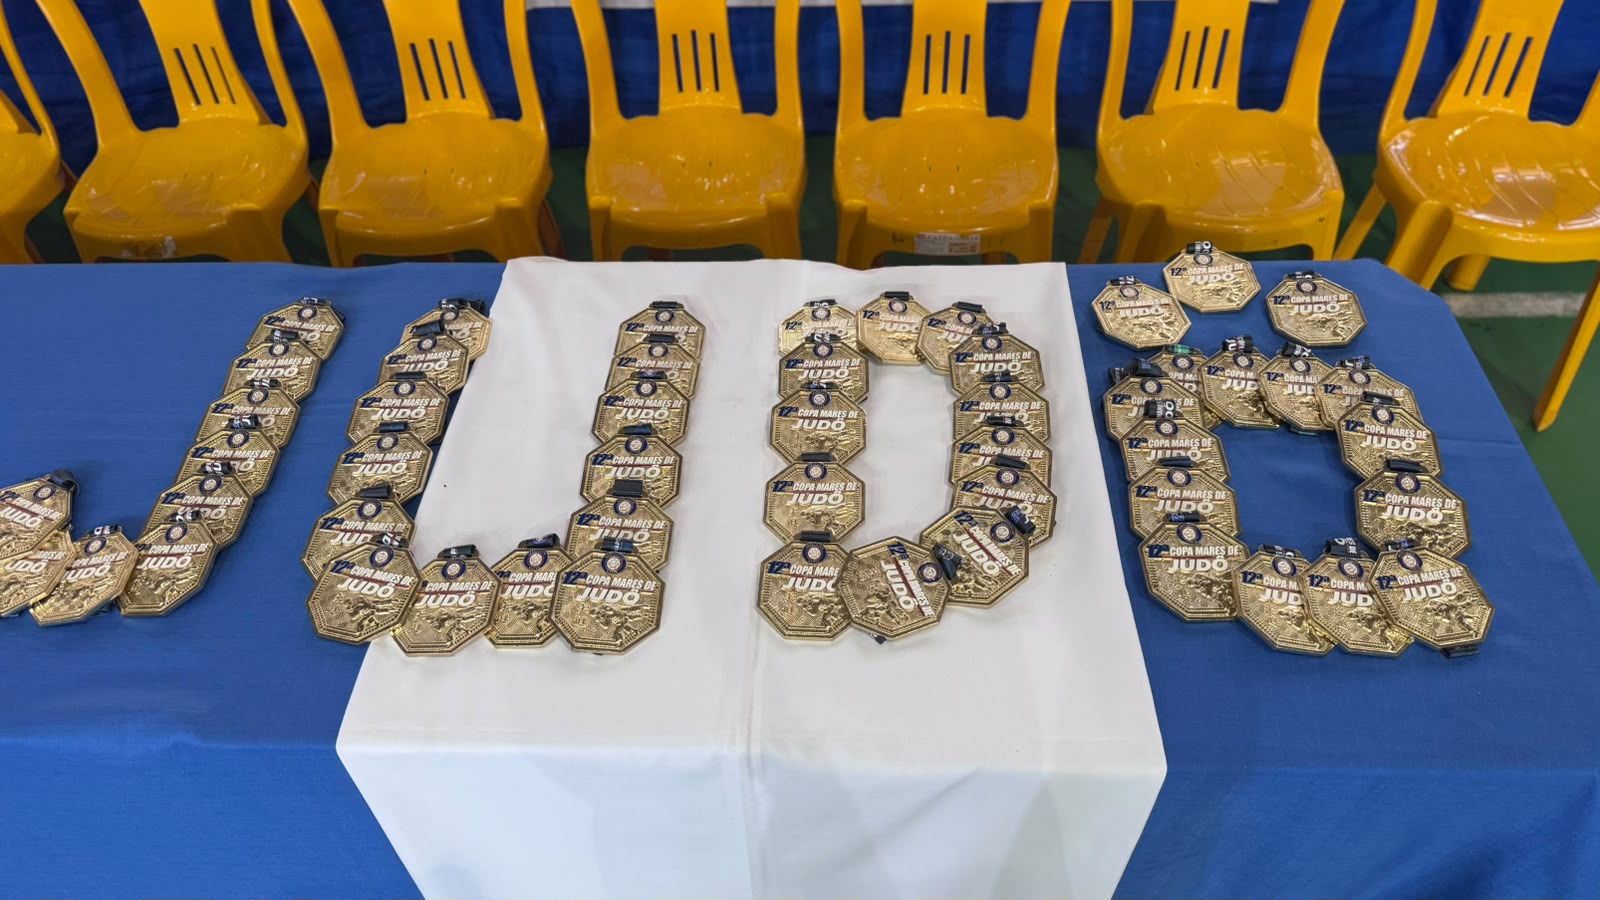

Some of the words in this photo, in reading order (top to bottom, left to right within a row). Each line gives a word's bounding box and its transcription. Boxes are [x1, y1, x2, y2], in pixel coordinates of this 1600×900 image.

[1221, 379, 1258, 390] JUD
[822, 410, 847, 418] MARES
[1364, 424, 1386, 433] COPA
[1387, 426, 1415, 438] MARES
[385, 452, 411, 461] MARES
[636, 456, 662, 464] MARES
[983, 486, 1006, 497] COPA
[1008, 490, 1036, 501] MARES
[1037, 494, 1049, 503] DE
[1157, 488, 1180, 498] COPA
[1182, 490, 1213, 499] MARES
[1385, 493, 1410, 504] COPA
[1411, 496, 1442, 508] MARES
[1445, 499, 1457, 509] DE
[342, 521, 364, 530] COPA
[366, 522, 394, 532] MARES
[598, 517, 622, 526] COPA
[624, 519, 652, 528] MARES
[330, 532, 373, 546] JUD
[1170, 546, 1194, 556] COPA
[1196, 546, 1226, 556] MARES
[1228, 546, 1239, 554] DE
[5, 560, 48, 573] UDÔ
[1168, 556, 1228, 573] JUDÔ
[790, 565, 812, 574] COPA
[814, 568, 840, 576] MARE
[351, 567, 374, 578] COPA
[374, 572, 403, 584] MARES
[401, 577, 415, 586] DE
[509, 573, 532, 581] COPA
[1263, 576, 1286, 587] COPA
[1397, 575, 1420, 586] COPA
[1420, 571, 1450, 583] MARES
[1450, 568, 1462, 577] DE
[426, 582, 449, 590] COPA
[451, 582, 480, 591] MARES
[480, 582, 493, 591] DE
[586, 576, 611, 586] COPA
[613, 579, 643, 590] MARES
[643, 581, 657, 590] DE
[1331, 578, 1354, 588] COPA
[577, 588, 639, 605] JUDÔ
[1259, 588, 1302, 606] JUD
[1328, 591, 1373, 607] JUD
